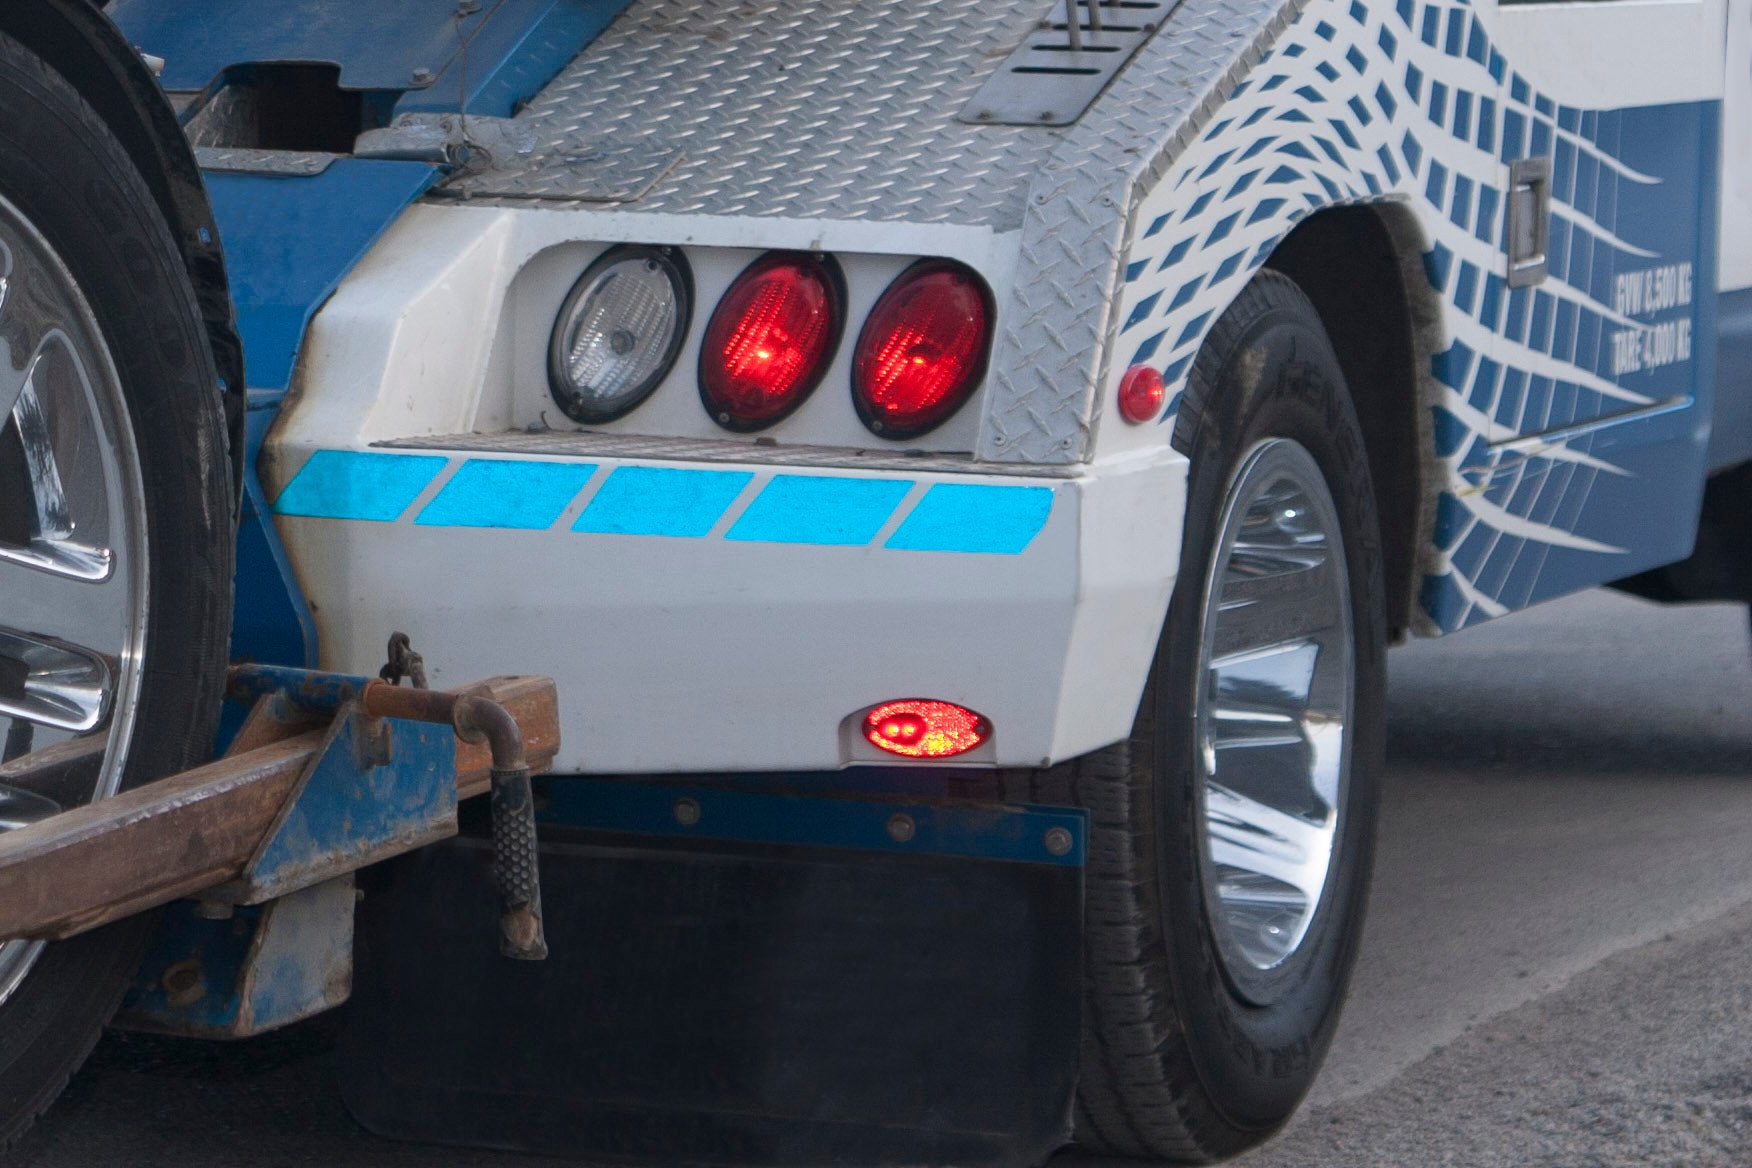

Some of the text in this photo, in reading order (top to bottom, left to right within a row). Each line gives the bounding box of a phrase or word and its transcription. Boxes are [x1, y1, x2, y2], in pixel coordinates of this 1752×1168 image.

[1616, 271, 1644, 316] GVW
[1678, 261, 1693, 305] KG
[1611, 329, 1642, 376] TARE
[1677, 317, 1692, 361] KG
